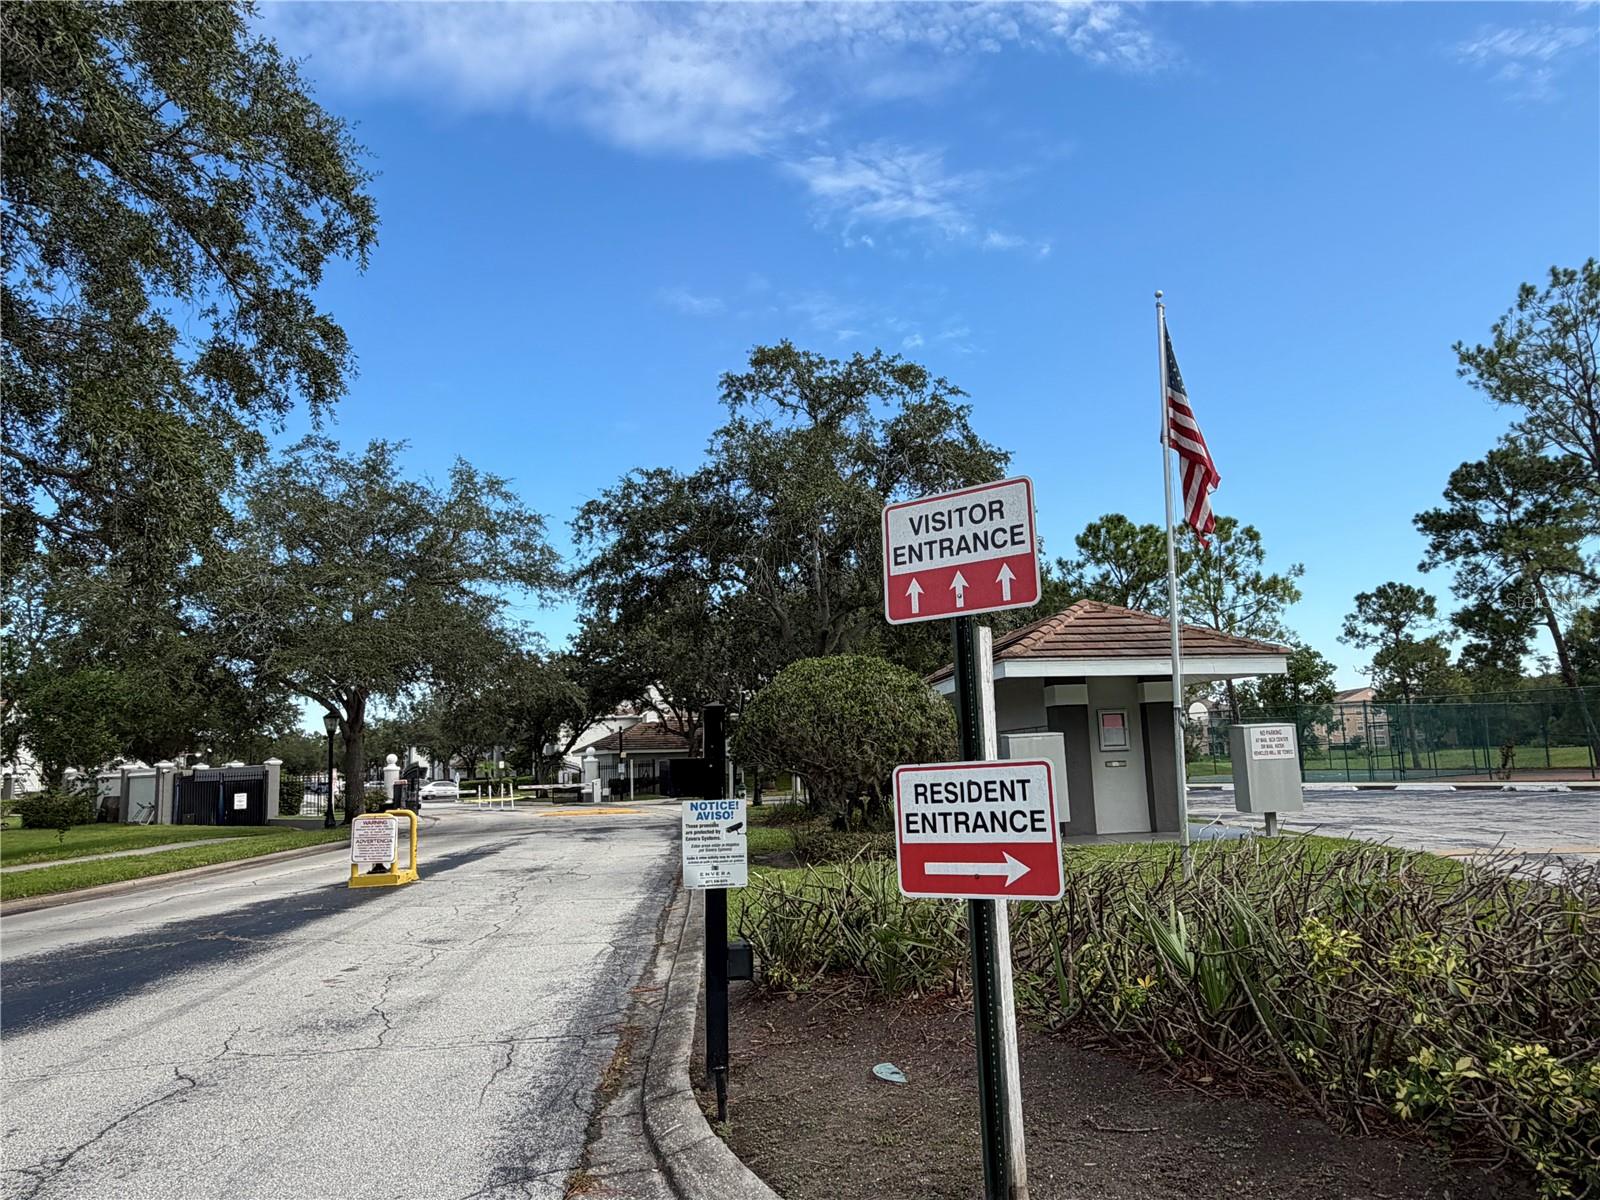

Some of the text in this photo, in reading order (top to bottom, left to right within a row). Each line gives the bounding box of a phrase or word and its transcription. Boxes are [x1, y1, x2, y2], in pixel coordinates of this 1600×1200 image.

[909, 500, 1004, 536] VISITOR
[894, 523, 1026, 566] ENTRANCE
[914, 779, 1031, 804] RESIDENT
[690, 801, 739, 811] NOTICE!
[696, 811, 734, 820] AVISO!
[905, 810, 1047, 834] ENTRANCE
